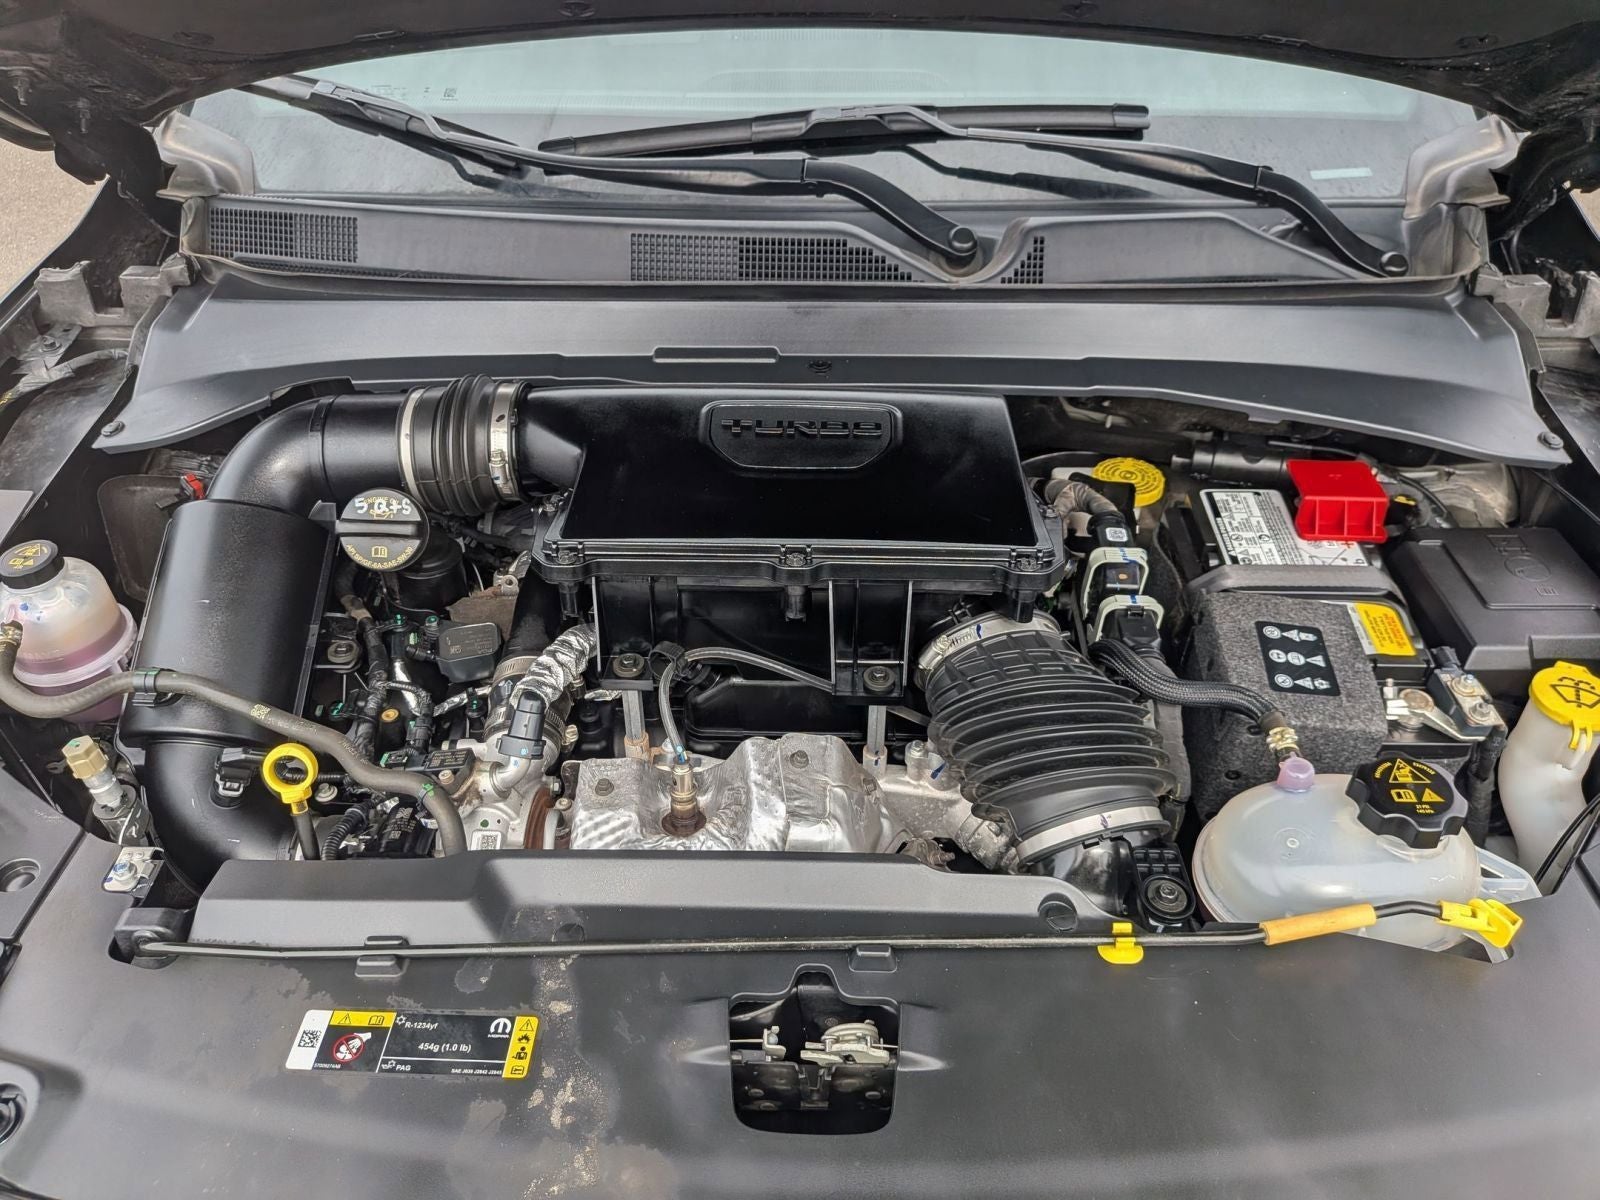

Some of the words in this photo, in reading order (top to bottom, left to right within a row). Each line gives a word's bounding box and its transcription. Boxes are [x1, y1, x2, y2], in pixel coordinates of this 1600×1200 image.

[721, 419, 882, 437] TURBO
[354, 497, 368, 513] 5
[404, 1021, 439, 1031] R-1234yf
[418, 1042, 440, 1053] 454g
[441, 1043, 458, 1053] (1.0
[459, 1043, 472, 1054] lb)
